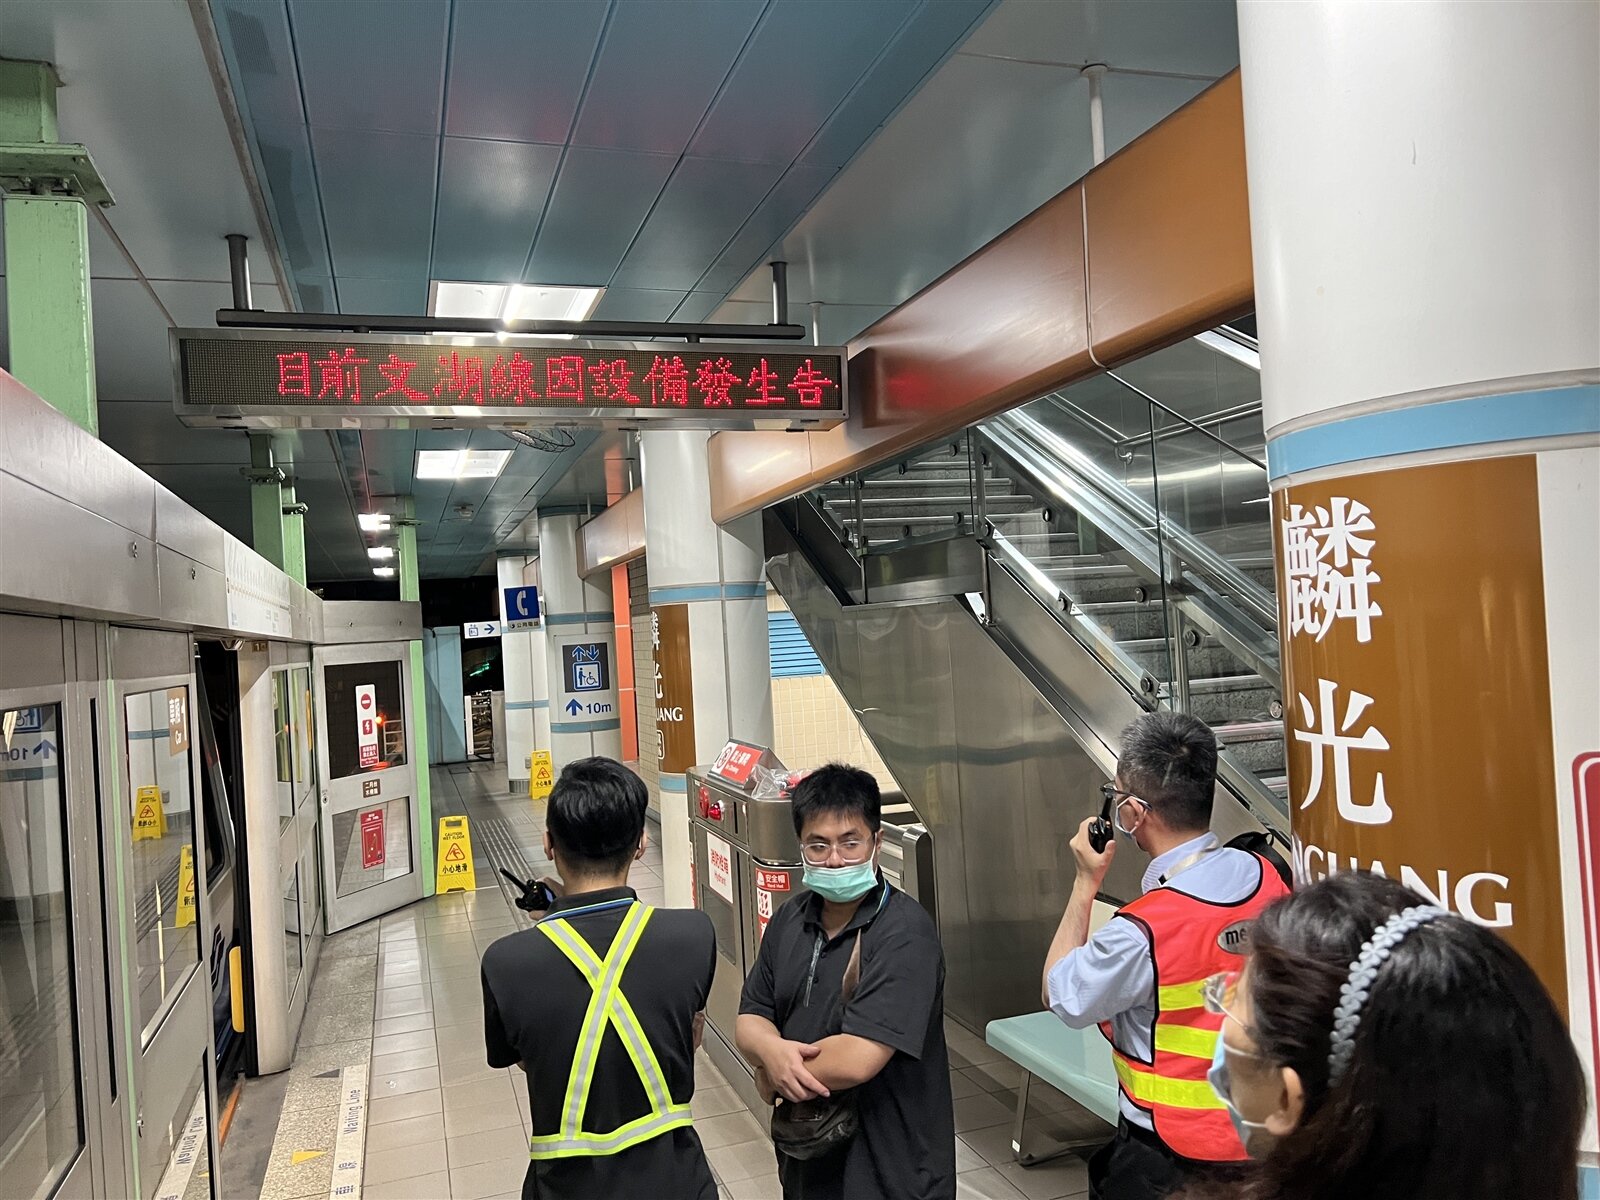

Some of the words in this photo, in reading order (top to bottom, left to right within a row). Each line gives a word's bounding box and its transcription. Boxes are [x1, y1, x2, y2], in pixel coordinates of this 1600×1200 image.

[277, 347, 833, 404] 目前文湖線因設備發生告
[1282, 497, 1393, 824] 麟光
[586, 702, 612, 714] 10m
[442, 863, 468, 874] 小心地滑
[765, 874, 786, 884] 安全帽
[346, 1089, 361, 1105] Line
[343, 1105, 363, 1135] Waiting
